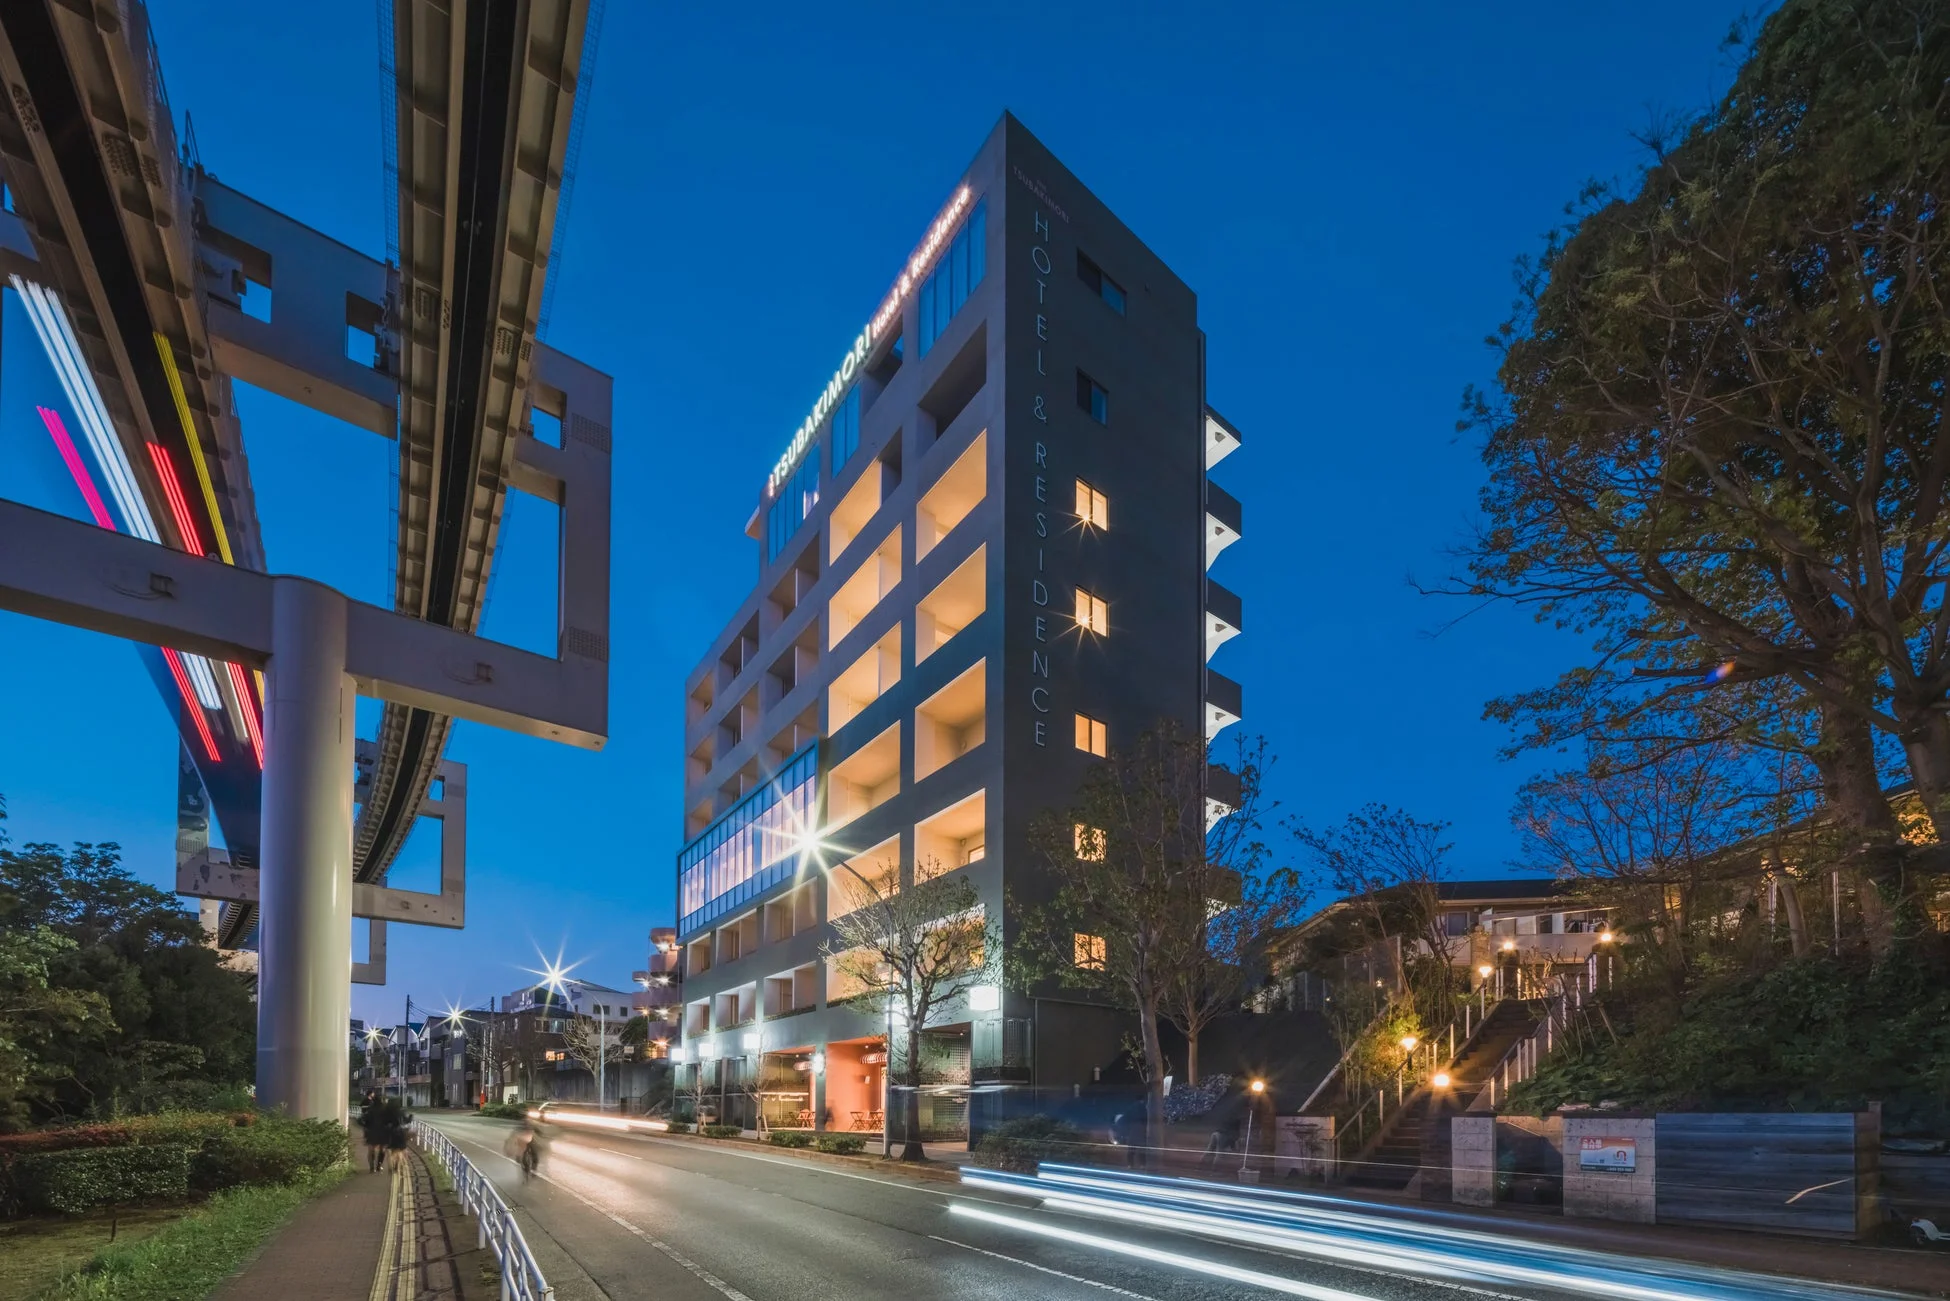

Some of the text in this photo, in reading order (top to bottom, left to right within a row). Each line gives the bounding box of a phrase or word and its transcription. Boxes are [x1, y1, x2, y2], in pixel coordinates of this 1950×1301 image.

[872, 287, 899, 338] Hotel
[911, 185, 969, 279] Residence
[1013, 165, 1069, 223] TSUBAKIMORI
[1032, 211, 1051, 377] HOTEL
[773, 322, 871, 486] TSUBAKIMORI
[1034, 396, 1047, 423] &
[1032, 442, 1049, 747] RESIDENCE
